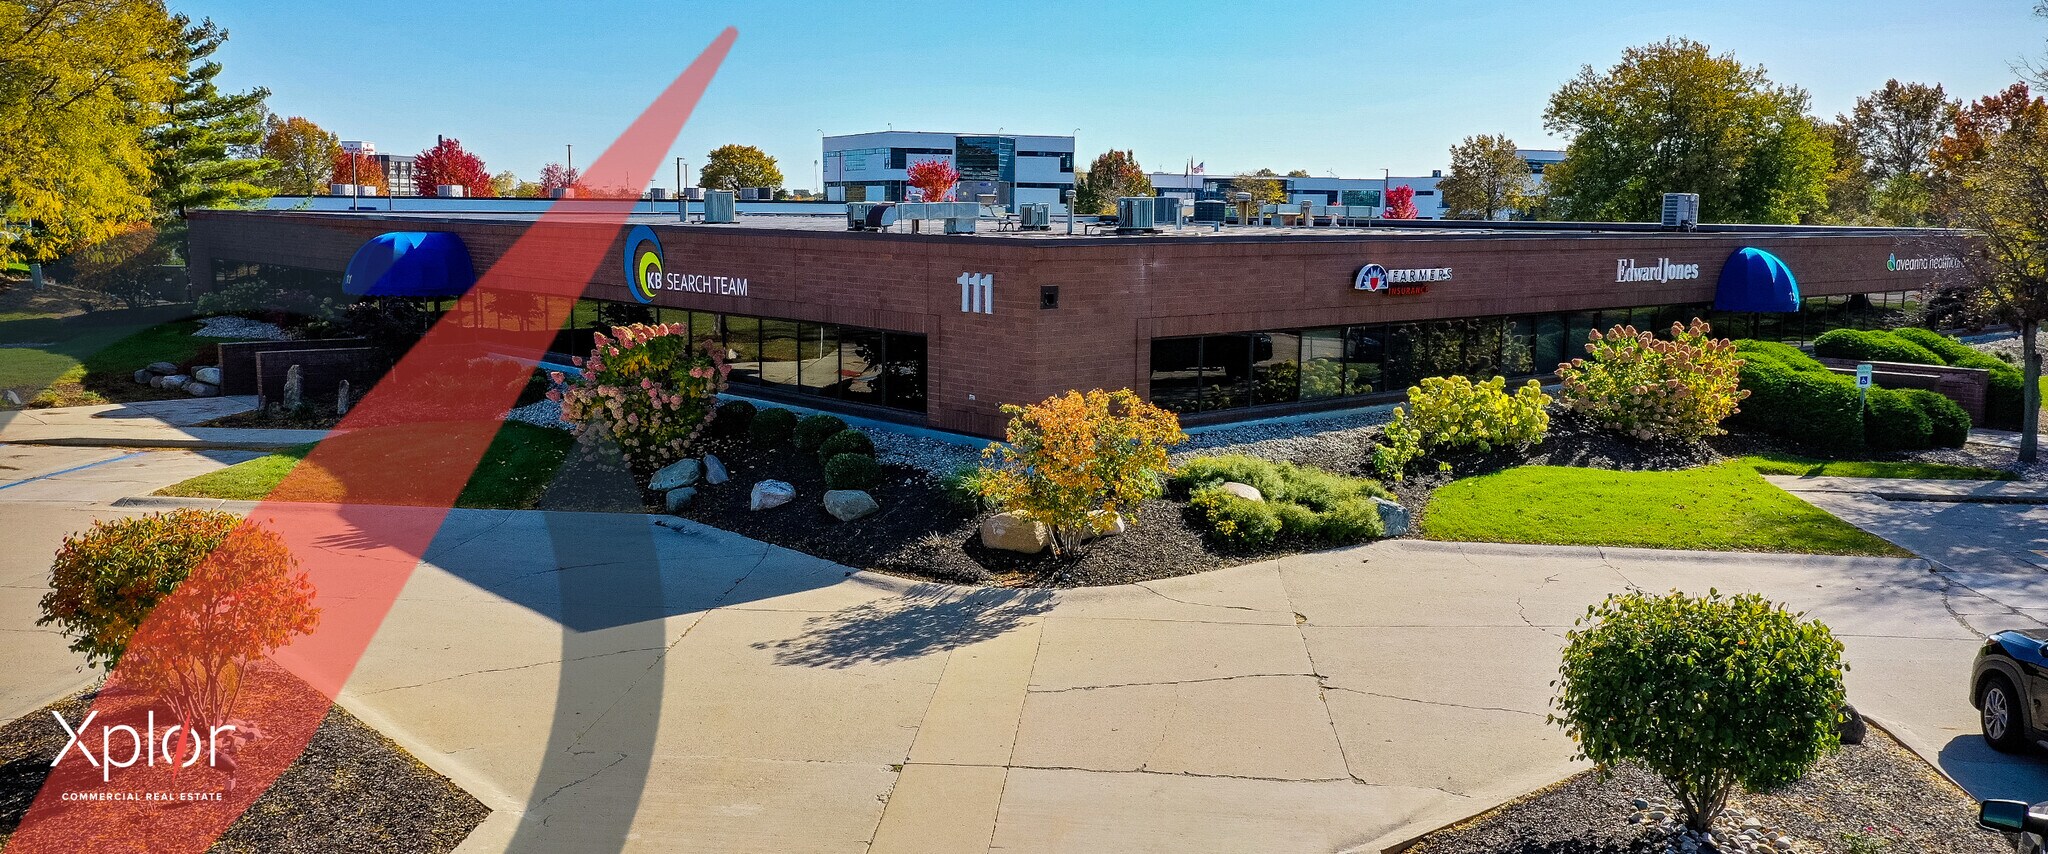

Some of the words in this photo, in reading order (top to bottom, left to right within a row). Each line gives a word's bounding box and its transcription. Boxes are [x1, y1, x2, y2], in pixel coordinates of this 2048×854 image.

[647, 272, 662, 289] KB
[667, 272, 711, 293] SEARCH
[713, 276, 748, 296] TEAM
[1392, 268, 1453, 282] FARMERS
[957, 272, 993, 314] 111
